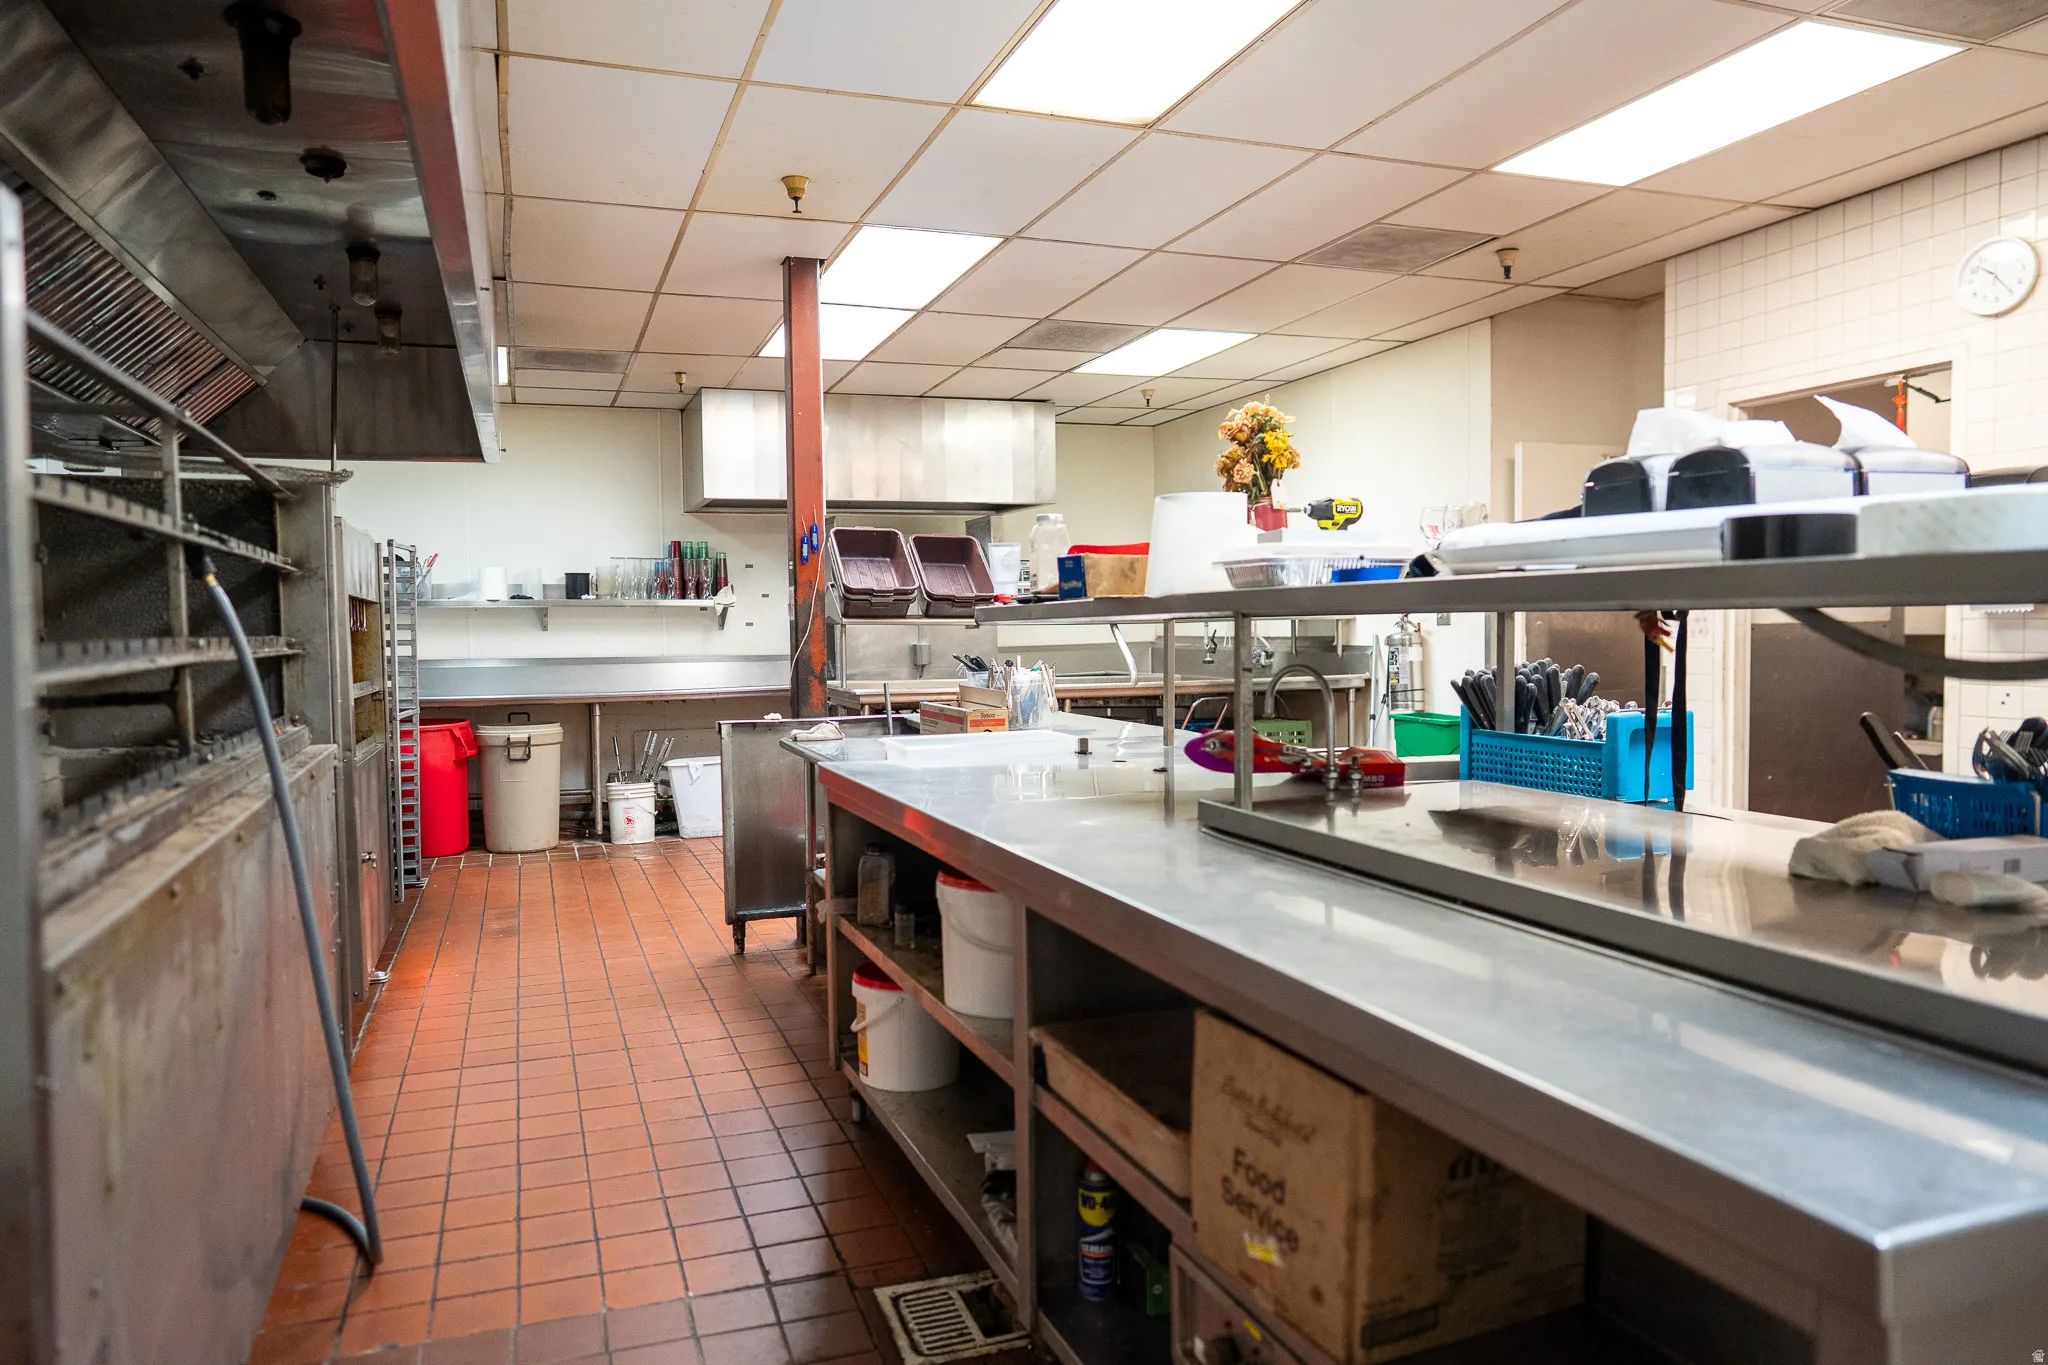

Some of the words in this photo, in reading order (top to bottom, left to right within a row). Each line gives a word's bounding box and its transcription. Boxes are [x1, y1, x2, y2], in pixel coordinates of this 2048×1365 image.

[1336, 504, 1357, 514] RYOBI
[980, 712, 996, 720] Sysco
[1233, 1147, 1287, 1206] Food
[1221, 1175, 1300, 1253] Service
